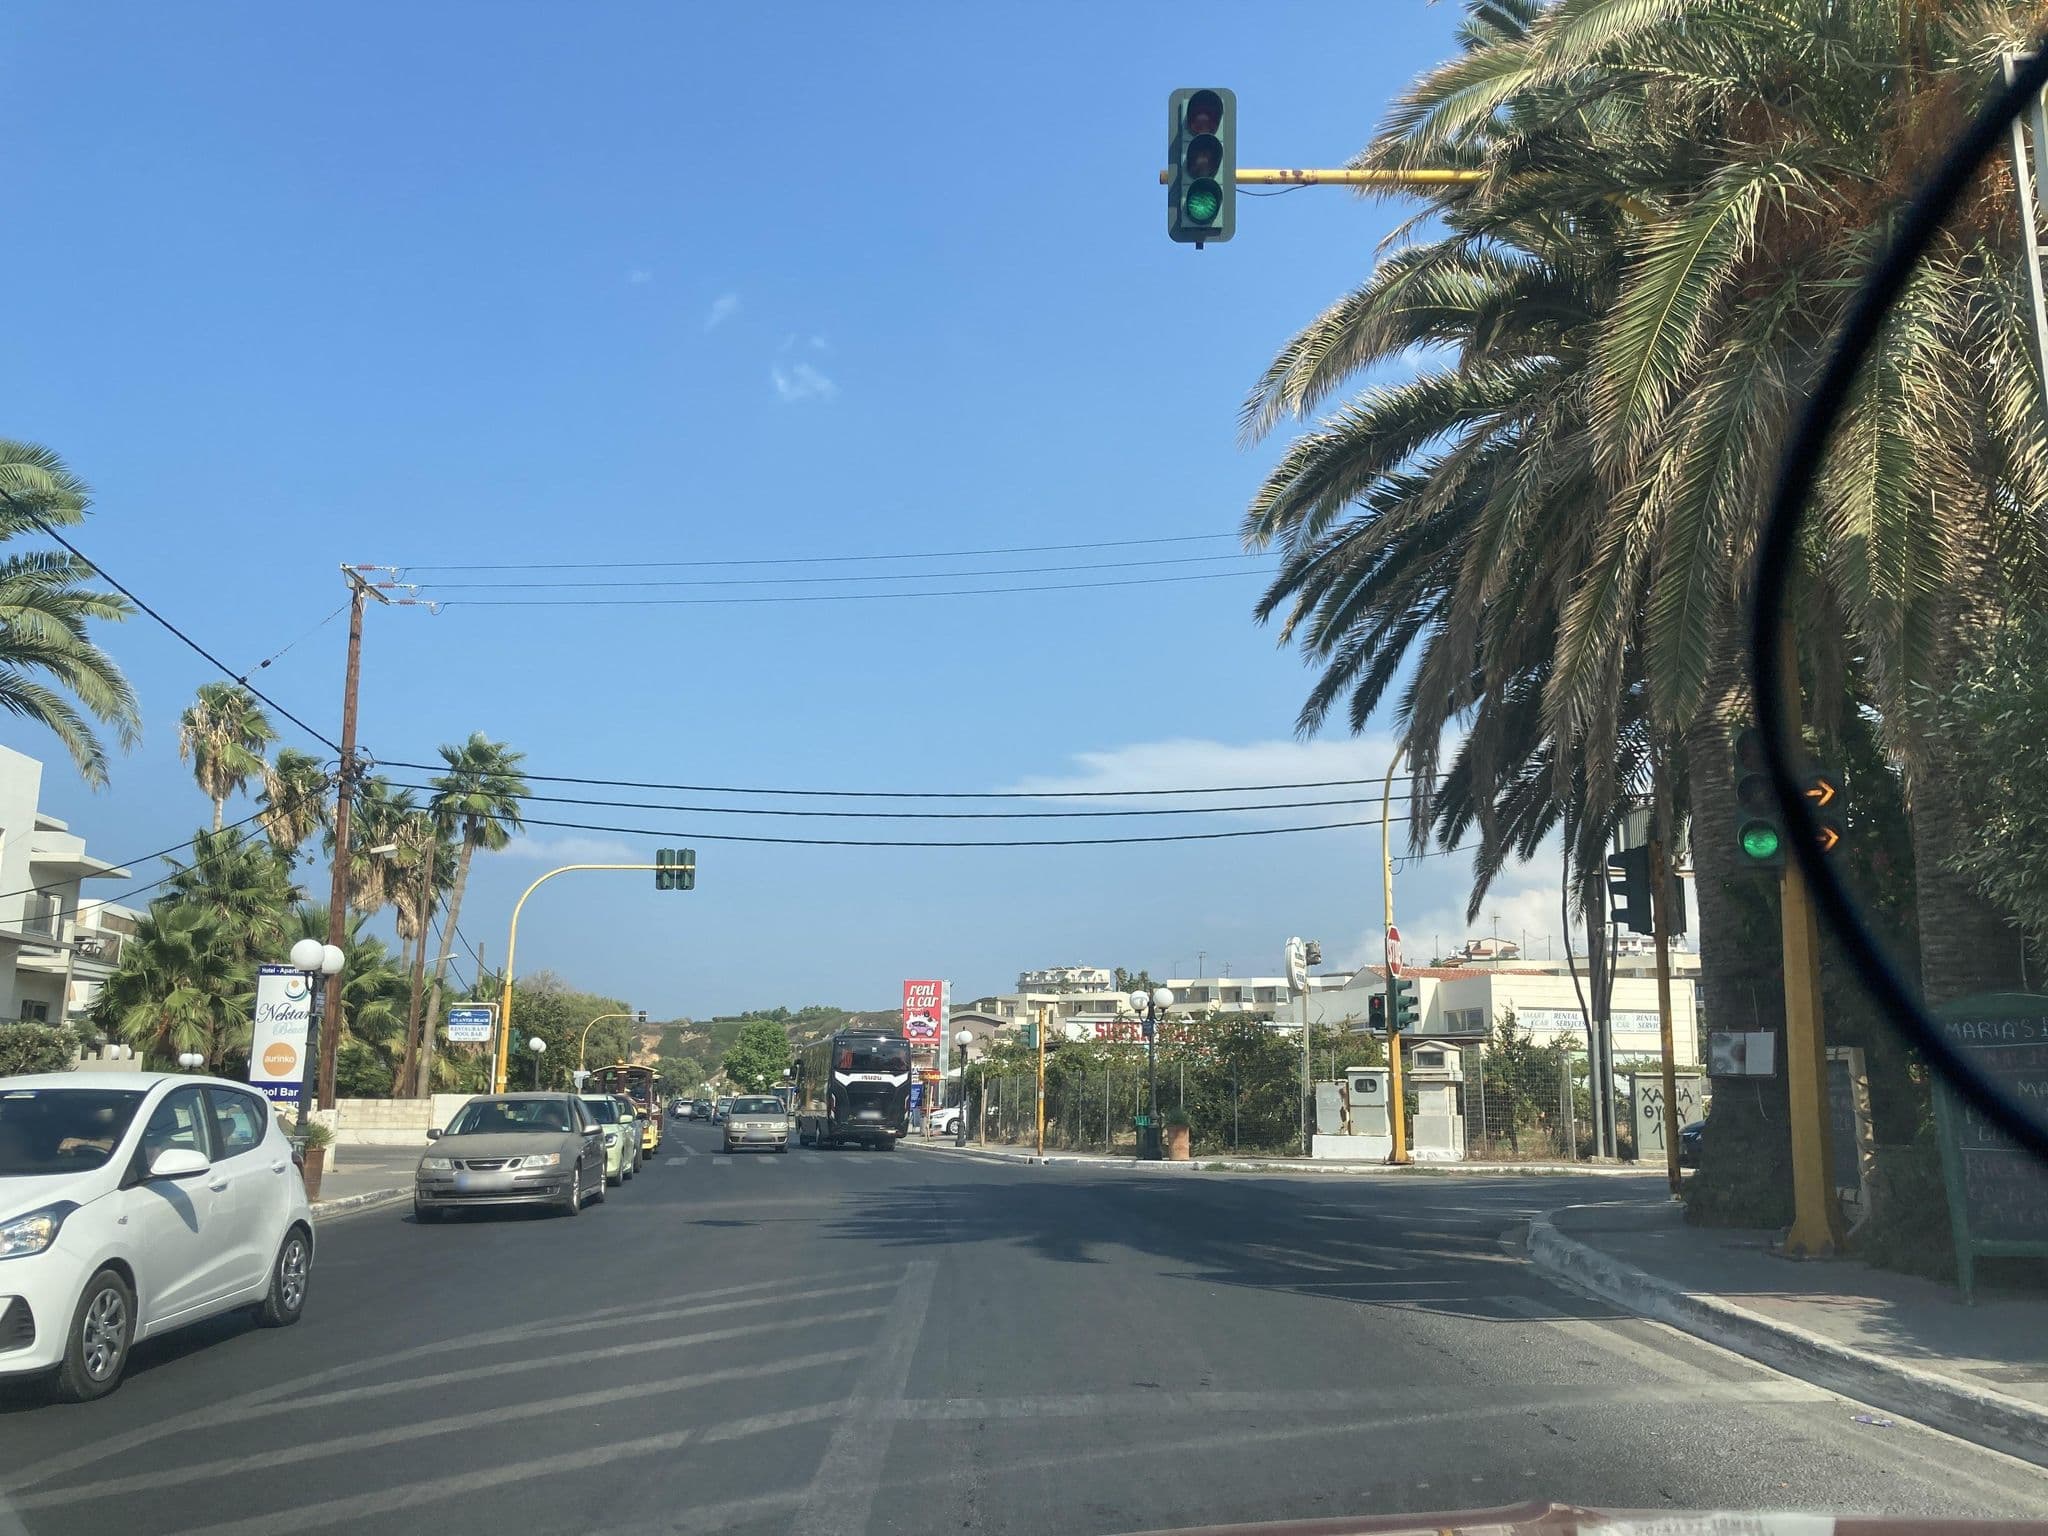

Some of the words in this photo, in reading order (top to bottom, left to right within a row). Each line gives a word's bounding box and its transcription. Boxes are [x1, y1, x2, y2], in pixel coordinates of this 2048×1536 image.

[909, 982, 936, 996] rent
[906, 996, 915, 1007] a
[917, 996, 939, 1007] car
[1556, 1020, 1586, 1028] SERVICES
[264, 1054, 295, 1064] aurinko
[279, 1087, 299, 1097] Bar
